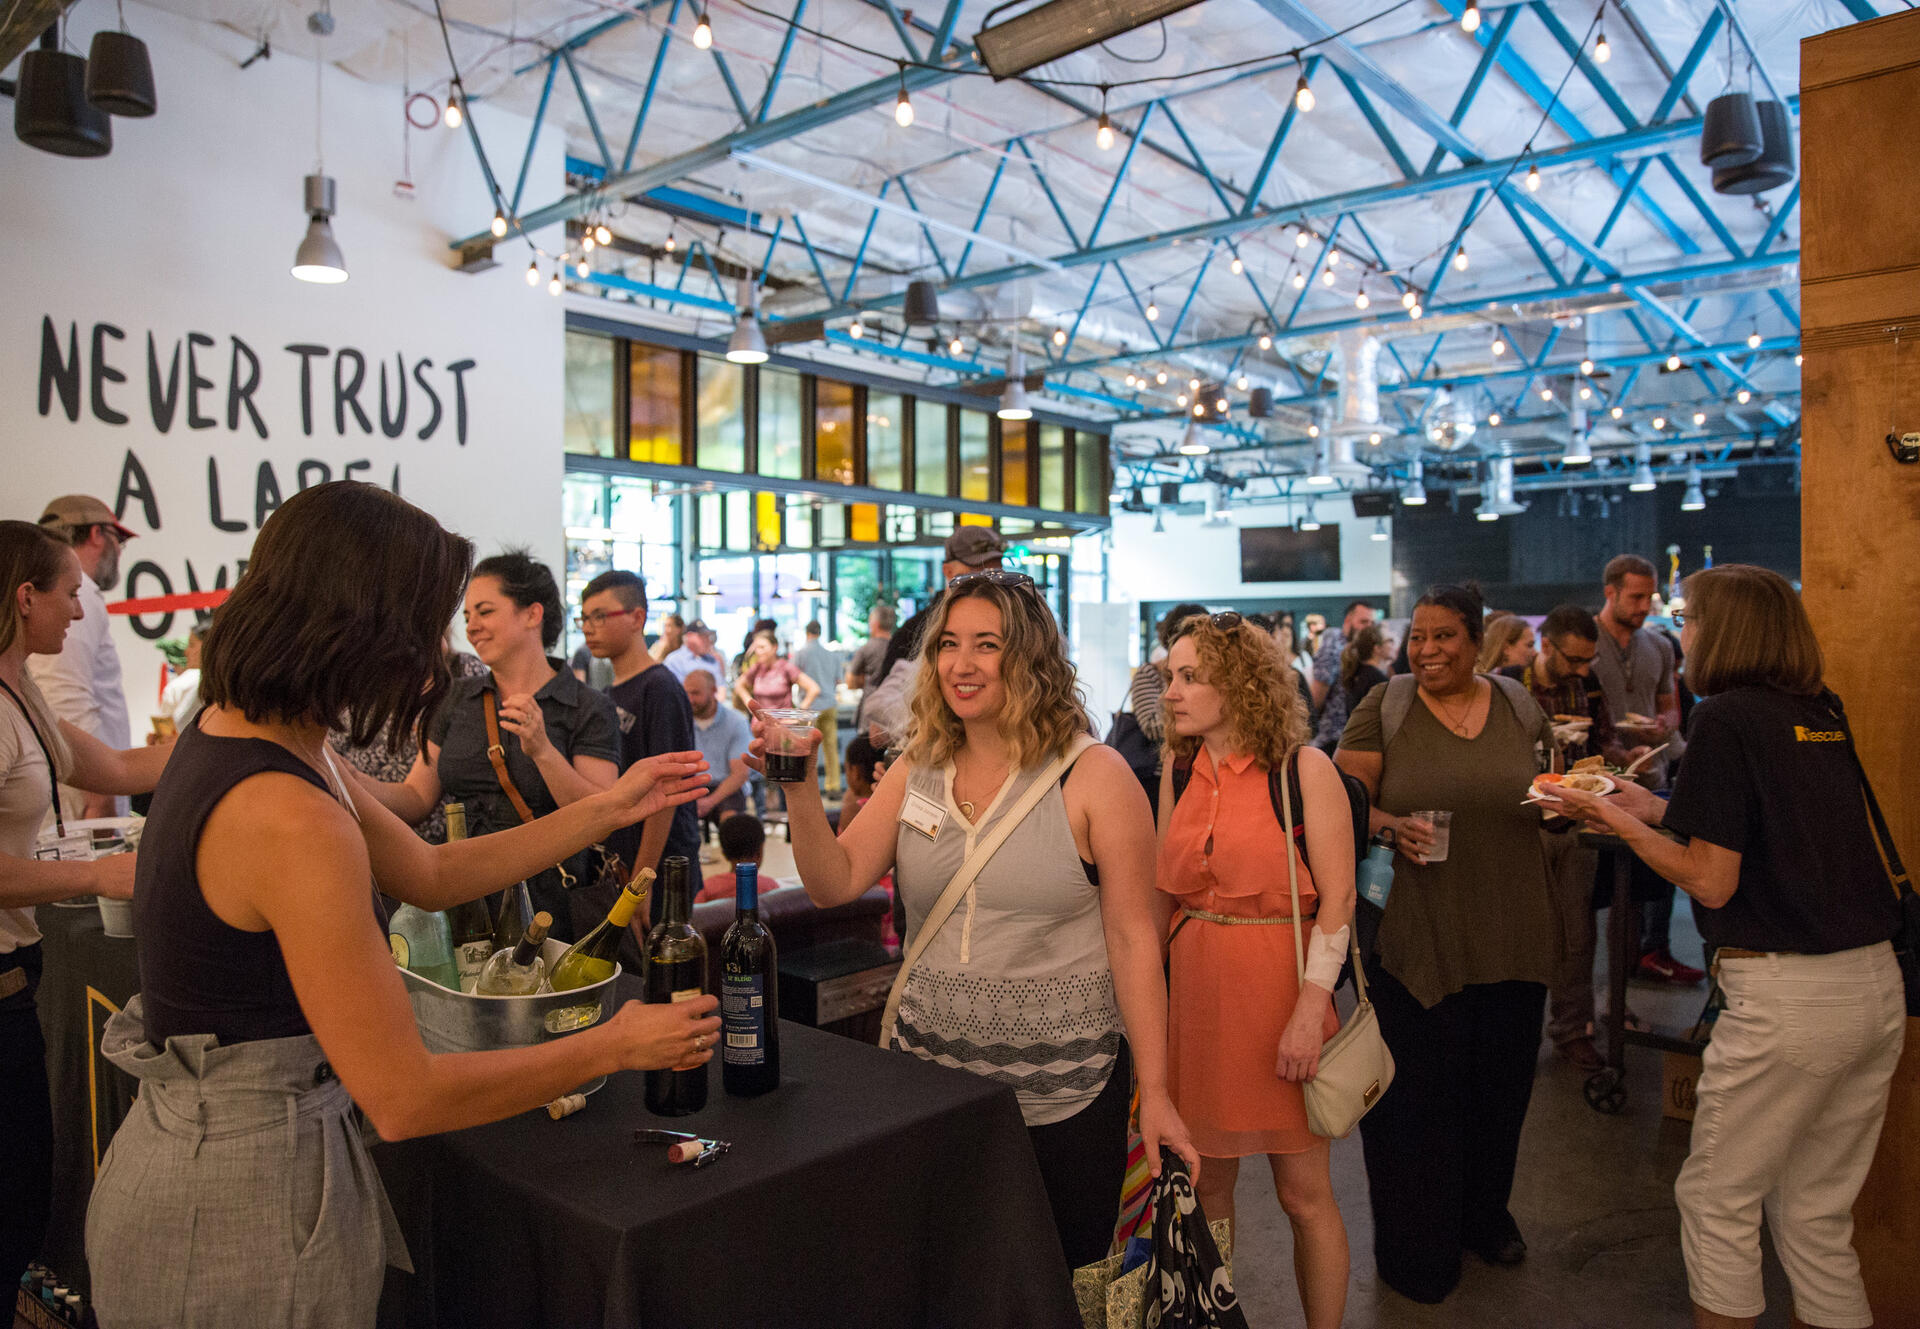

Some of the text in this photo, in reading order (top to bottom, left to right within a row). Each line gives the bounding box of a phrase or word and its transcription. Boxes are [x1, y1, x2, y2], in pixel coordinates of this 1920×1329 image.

[37, 314, 476, 446] NEVER TRUST
[115, 447, 161, 530] A
